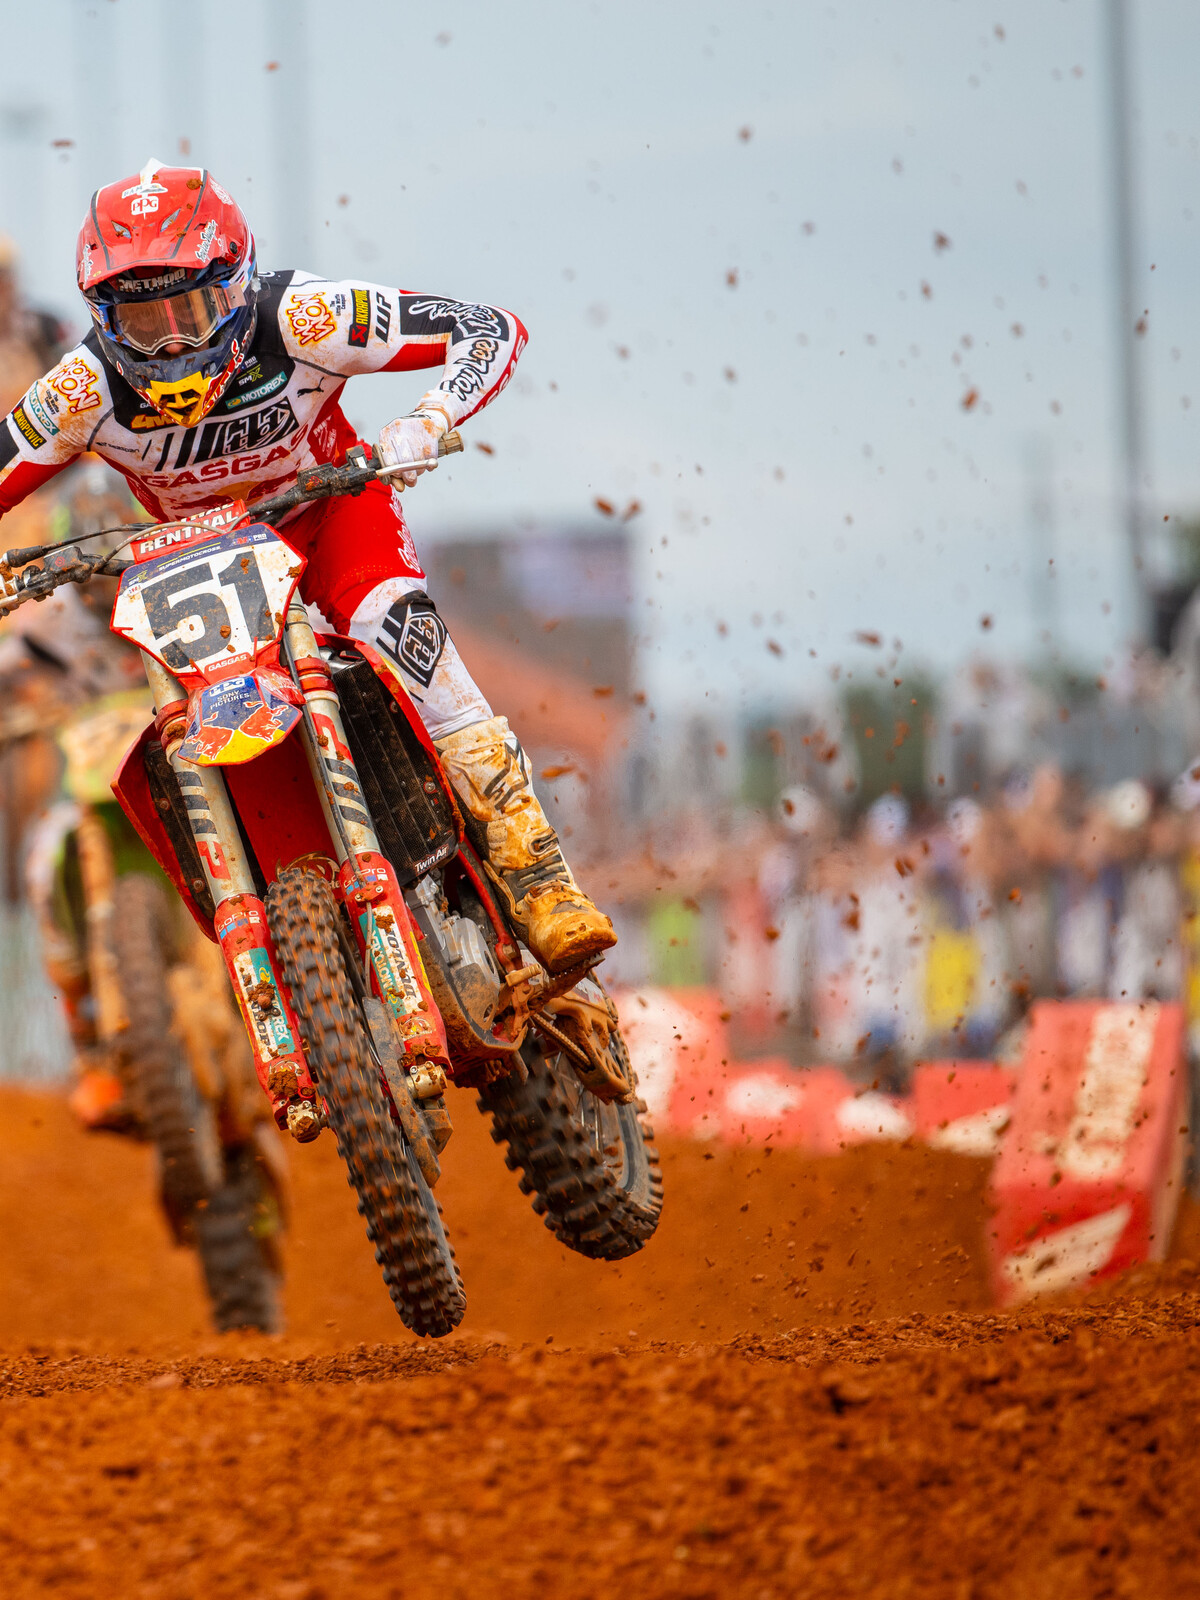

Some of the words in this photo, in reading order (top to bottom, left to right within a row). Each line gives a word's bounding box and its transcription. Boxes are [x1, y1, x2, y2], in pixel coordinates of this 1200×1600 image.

[241, 375, 285, 403] MOTOREX
[140, 510, 239, 554] RENTHAL
[158, 546, 221, 571] SUPERMOTOCROSS
[141, 551, 275, 669] 51
[208, 654, 247, 671] GASGAS
[210, 692, 250, 709] PICTURES
[217, 690, 240, 701] SONY
[414, 855, 436, 873] Twin
[436, 846, 448, 861] Air
[217, 910, 259, 933] GoPro
